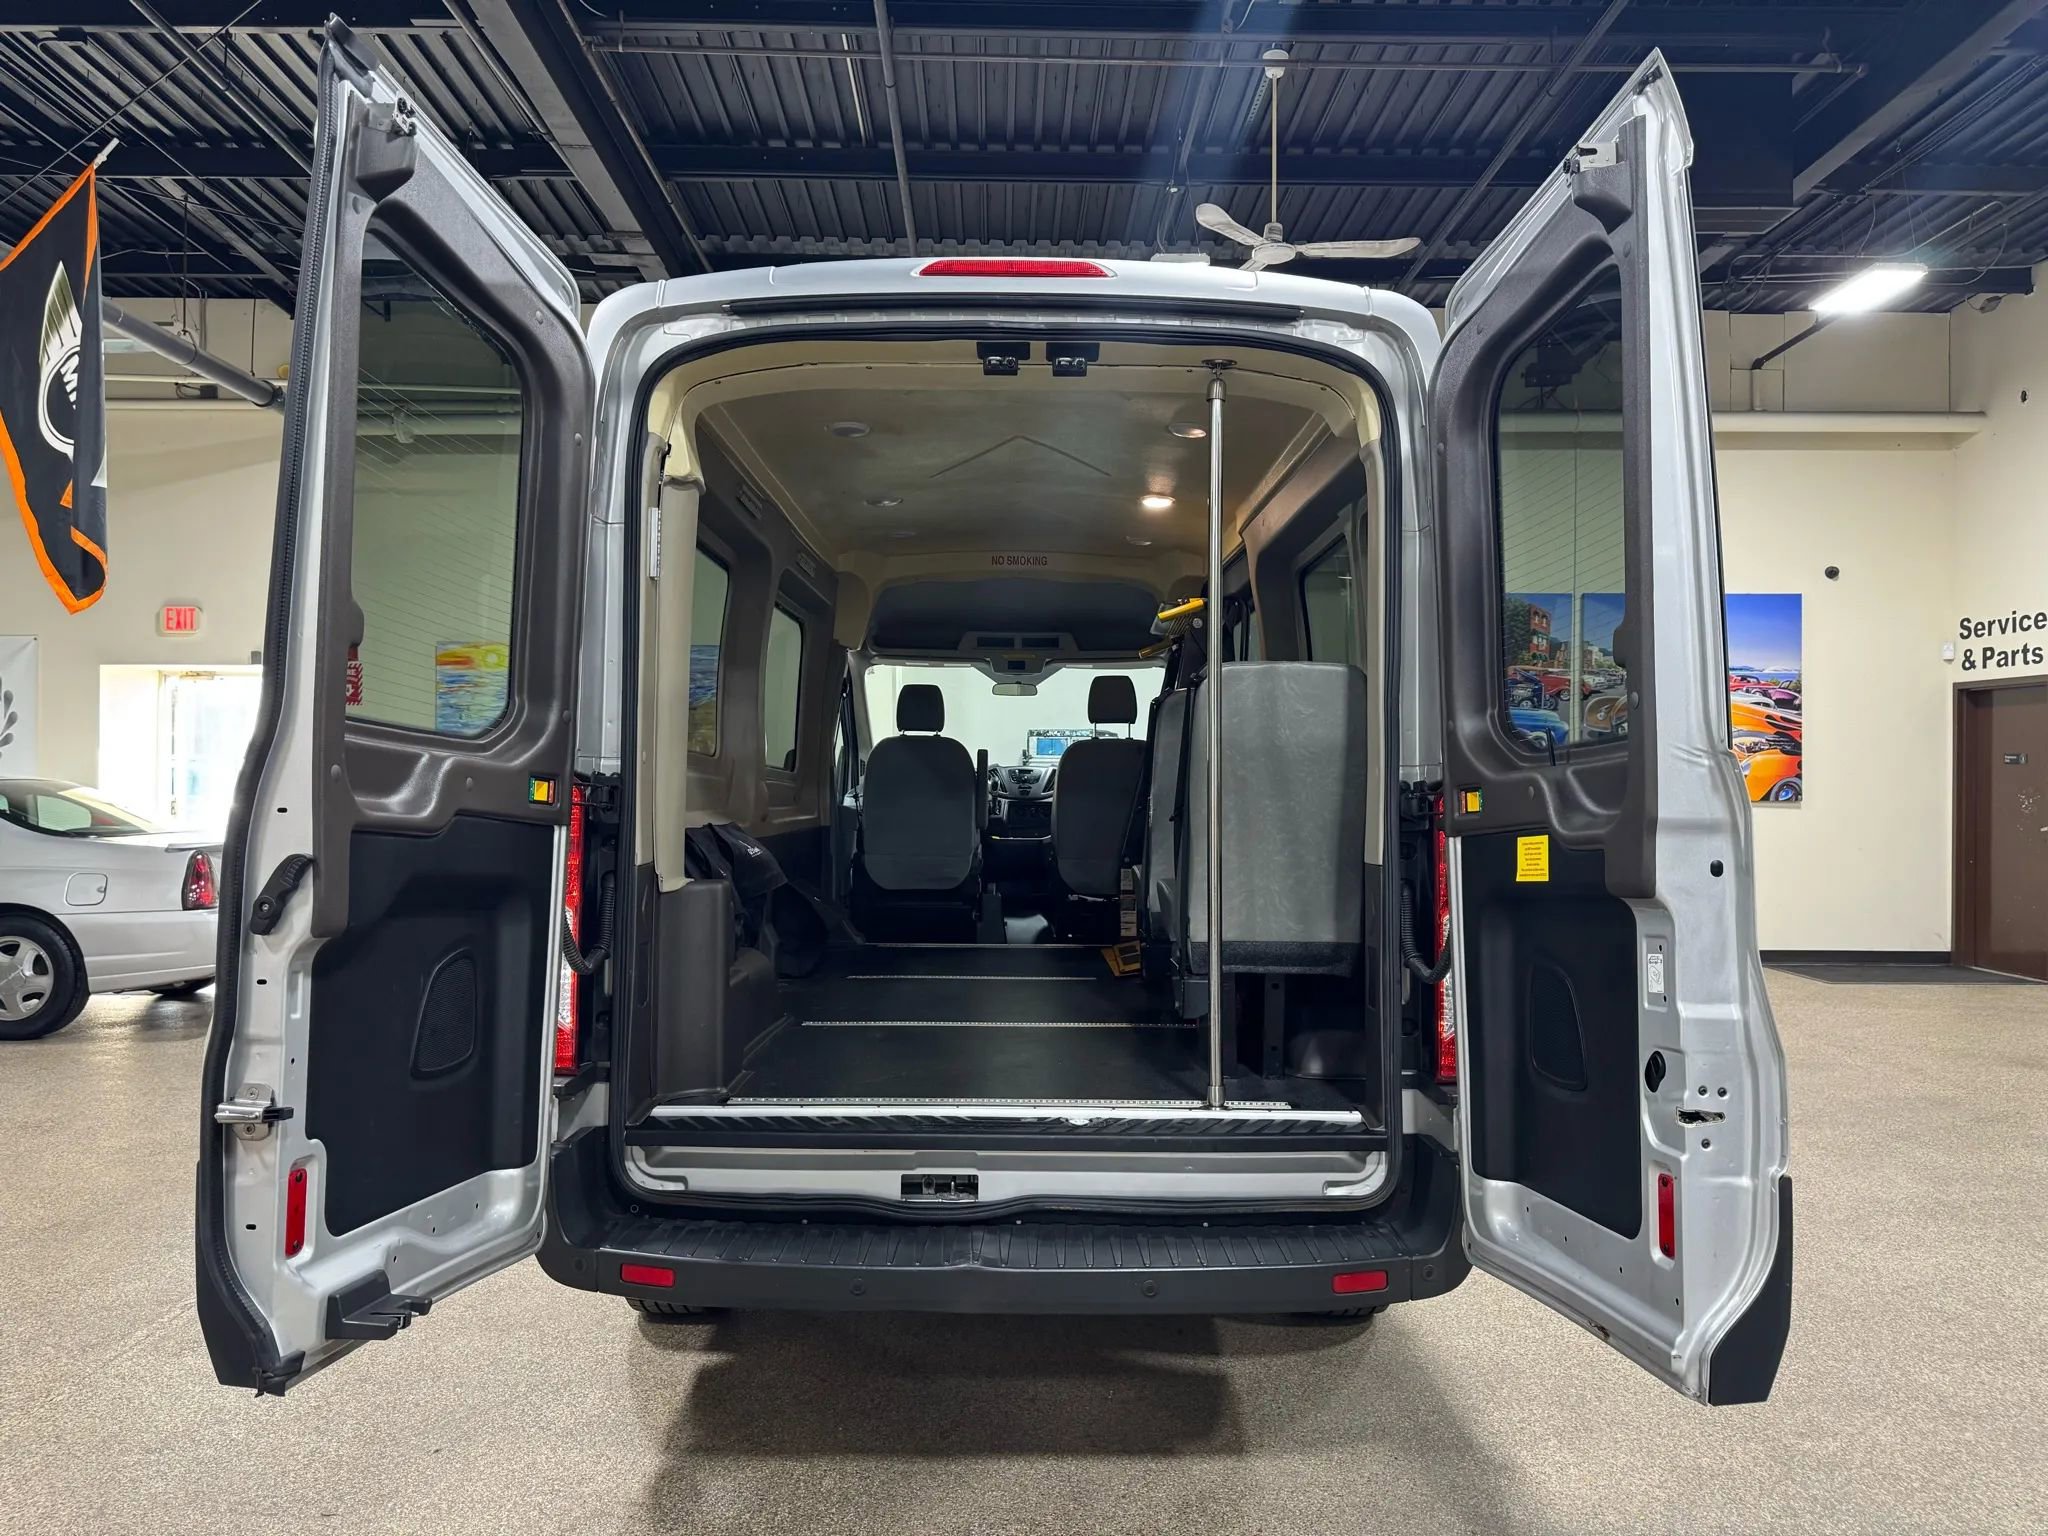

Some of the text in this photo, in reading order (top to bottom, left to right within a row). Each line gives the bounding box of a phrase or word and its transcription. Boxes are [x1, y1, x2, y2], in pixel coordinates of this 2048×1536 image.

[991, 555, 1048, 566] NO SMOKING
[166, 607, 196, 631] EXIT
[1959, 610, 2048, 640] Service
[1961, 642, 2044, 672] & Parts
